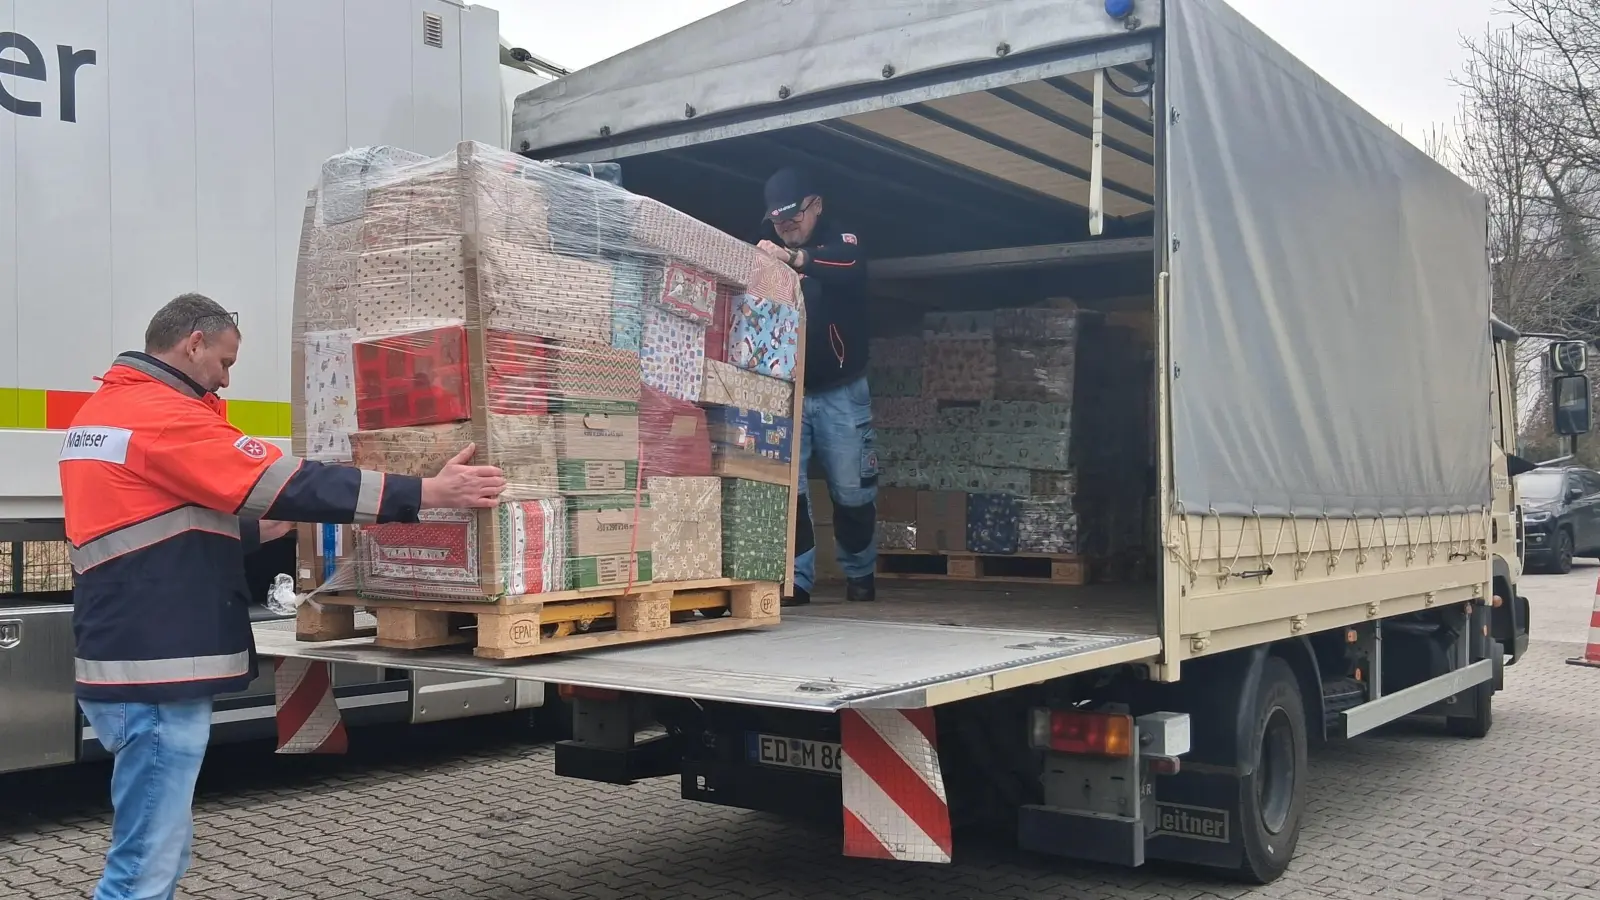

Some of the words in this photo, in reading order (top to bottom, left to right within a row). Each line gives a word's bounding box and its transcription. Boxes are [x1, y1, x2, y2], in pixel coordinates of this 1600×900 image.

[66, 430, 108, 448] Malteser
[761, 738, 788, 763] ED
[801, 742, 815, 767] M
